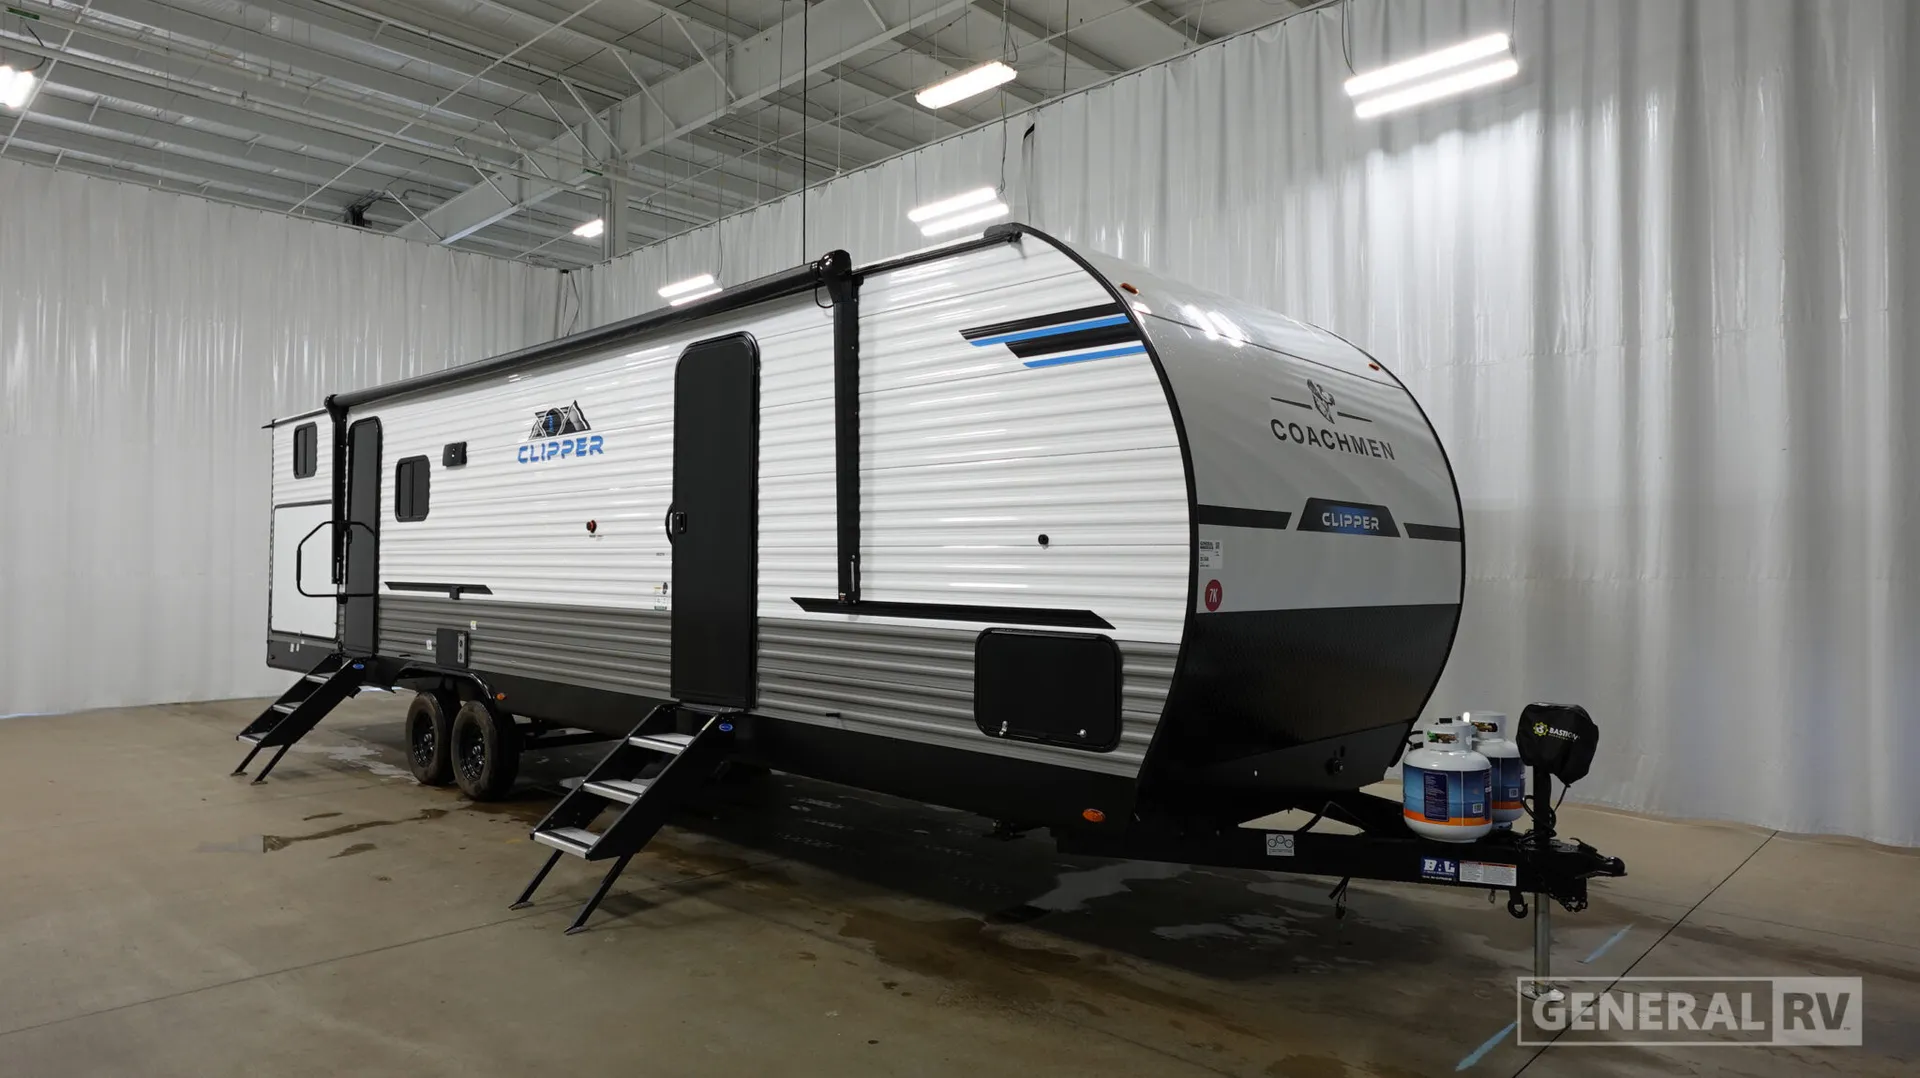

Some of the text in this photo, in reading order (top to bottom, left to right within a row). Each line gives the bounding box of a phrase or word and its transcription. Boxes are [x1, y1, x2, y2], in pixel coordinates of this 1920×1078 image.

[1270, 419, 1395, 460] COACHMEN
[517, 435, 604, 464] CLIPPER
[1322, 512, 1379, 530] CLIPPER
[1209, 588, 1218, 603] 7K
[1549, 727, 1578, 740] BASTION
